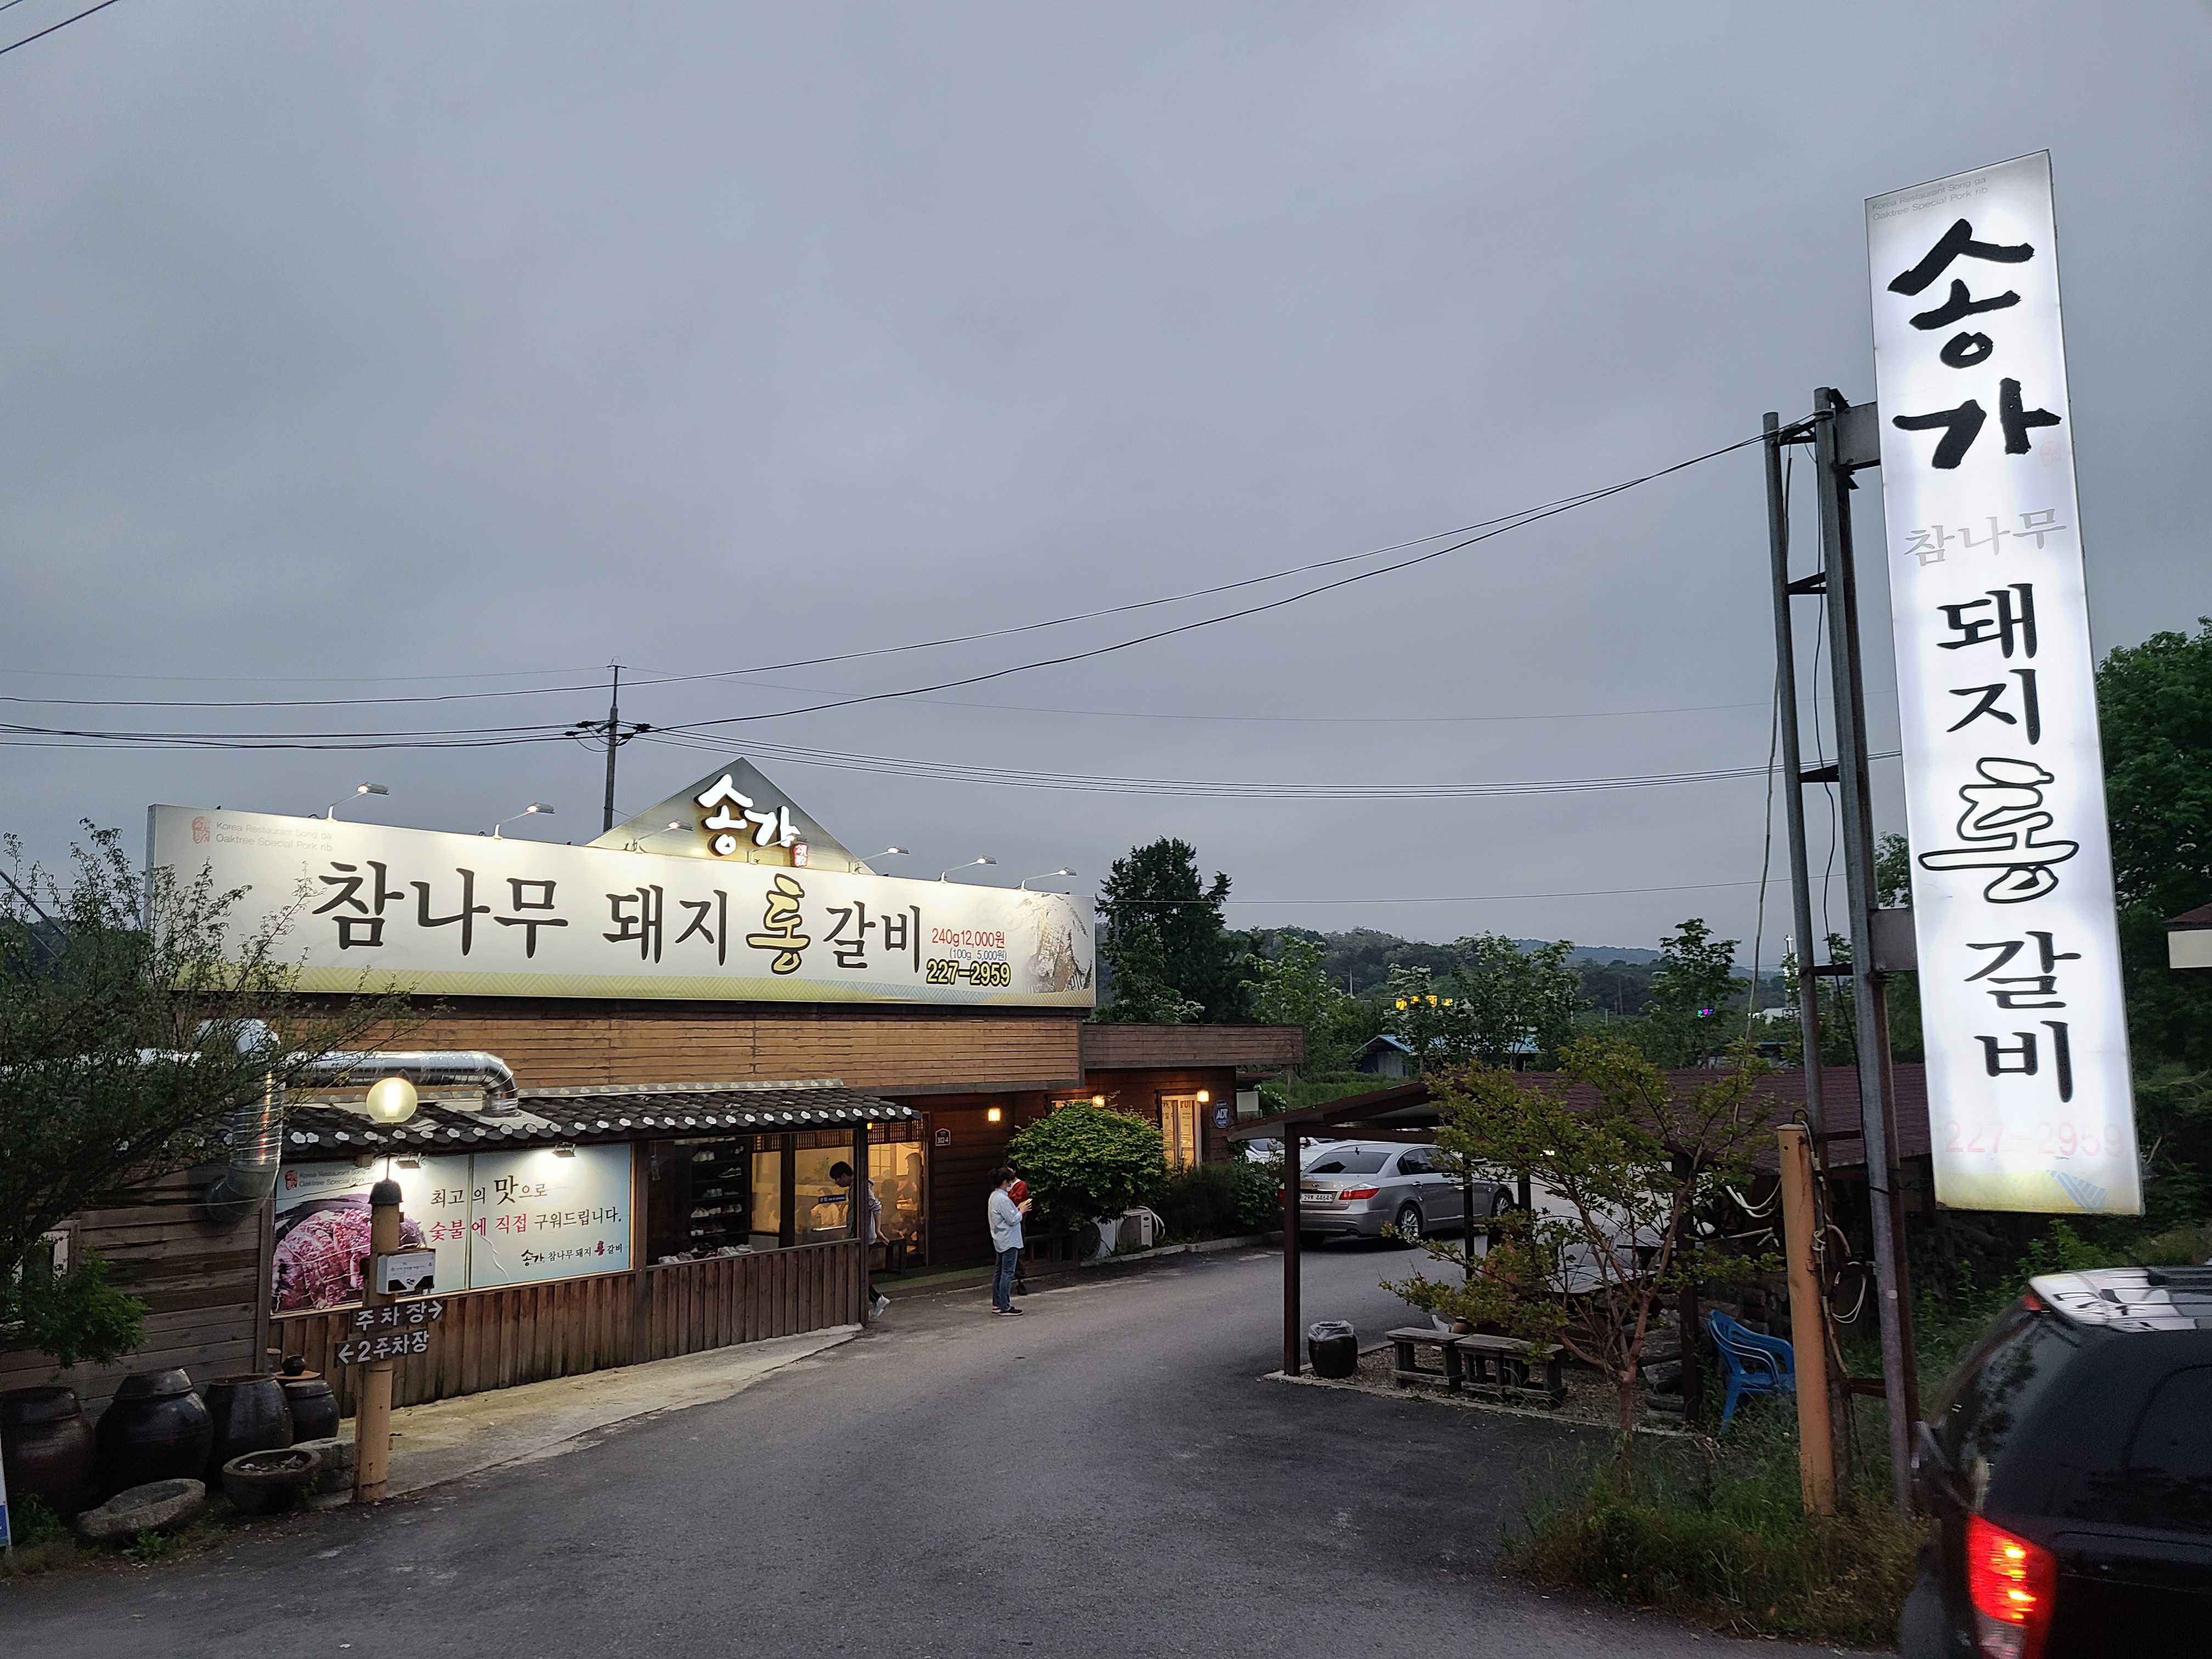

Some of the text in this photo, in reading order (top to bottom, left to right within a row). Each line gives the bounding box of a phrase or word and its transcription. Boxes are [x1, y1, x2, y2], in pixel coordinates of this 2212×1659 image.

[1872, 177, 1987, 211] Korea Restaurant Song ga
[1872, 186, 1988, 221] Oaktree Special Pork rib
[1887, 218, 2062, 470] 송가
[1903, 508, 2067, 567] 참나무
[695, 773, 802, 856] 송가
[216, 822, 332, 840] Korea Restaurant Song ga
[216, 833, 332, 852] Oaktree Special Pork rib
[312, 860, 569, 960] 참나무
[602, 884, 728, 966] 돼지
[949, 947, 972, 960] (100g
[926, 958, 1012, 987] 227-2959
[1216, 1108, 1228, 1119] ADT
[1944, 1119, 2126, 1158] 227-2959
[326, 1178, 351, 1186] Special
[495, 1213, 527, 1234] 직접
[533, 1206, 622, 1231] 구워드립니다.
[521, 1249, 545, 1267] 송가
[548, 1249, 574, 1262] 참나무
[575, 1247, 591, 1258] 돼지
